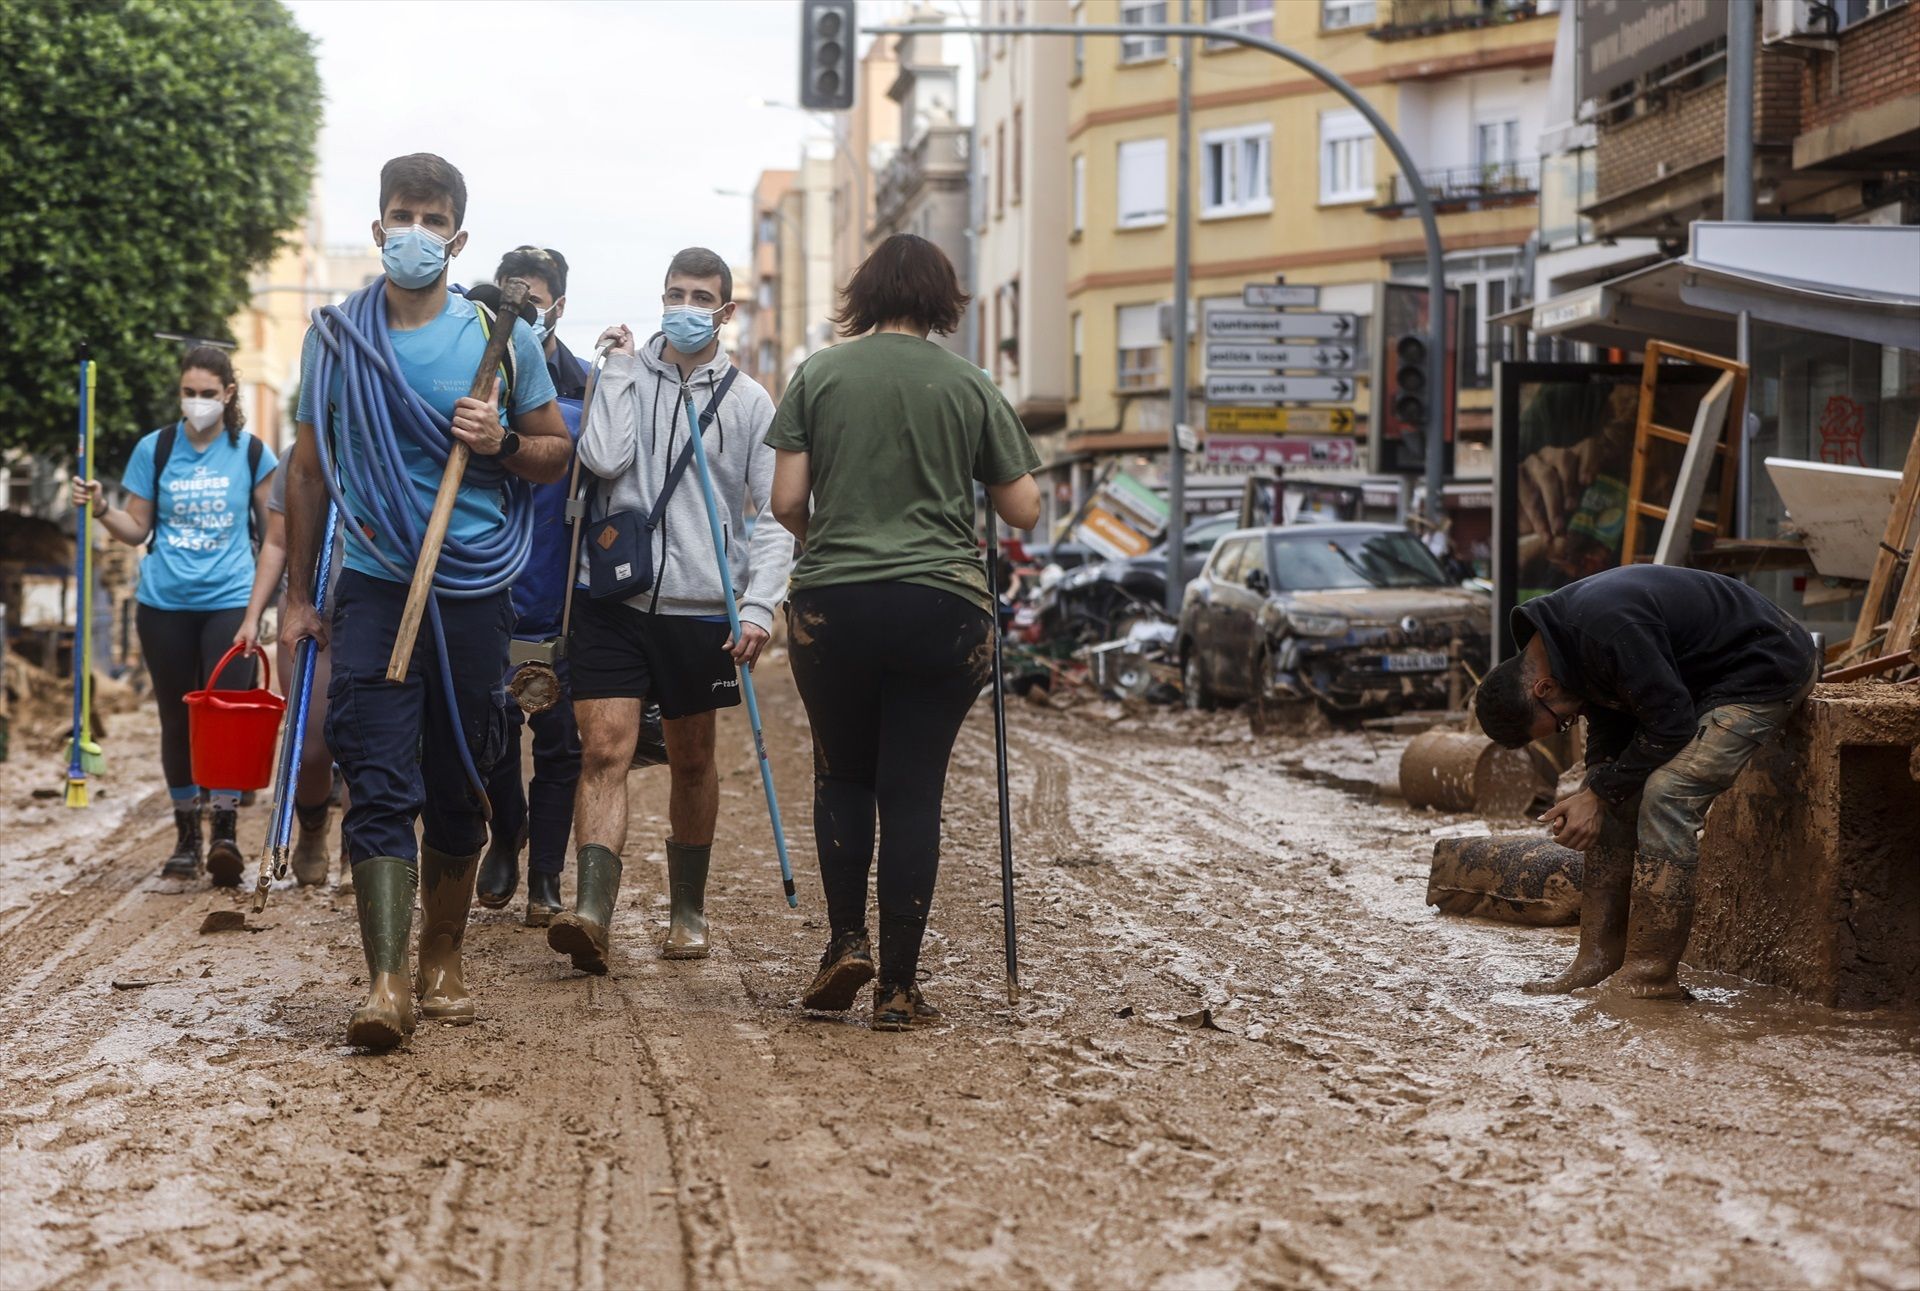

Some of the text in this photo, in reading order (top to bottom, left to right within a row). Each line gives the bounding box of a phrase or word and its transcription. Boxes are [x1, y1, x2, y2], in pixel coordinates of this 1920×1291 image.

[1256, 350, 1288, 362] local
[170, 477, 230, 491] QUIERES
[173, 499, 227, 515] CASO
[168, 535, 217, 551] VASO
